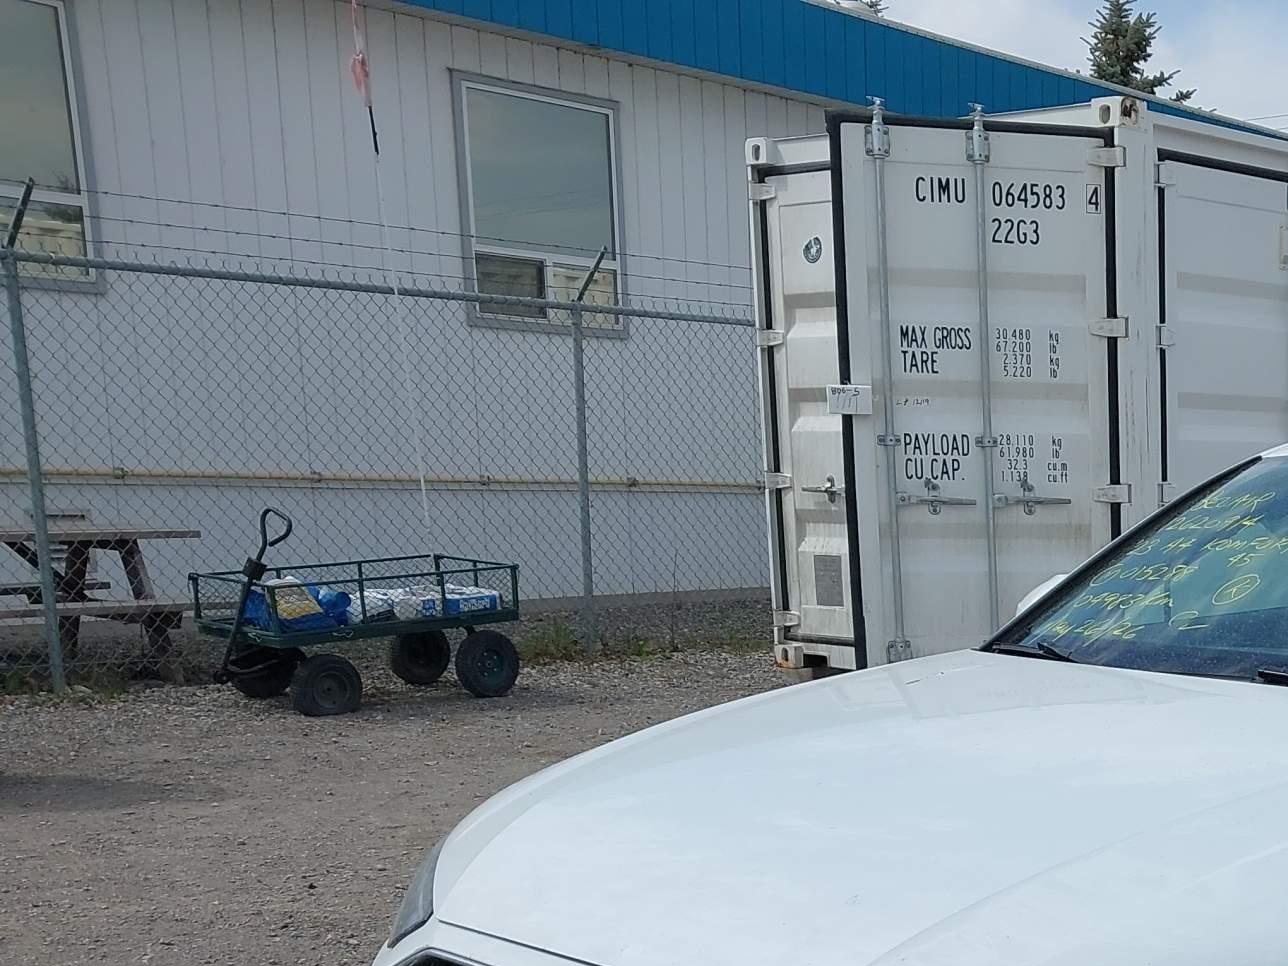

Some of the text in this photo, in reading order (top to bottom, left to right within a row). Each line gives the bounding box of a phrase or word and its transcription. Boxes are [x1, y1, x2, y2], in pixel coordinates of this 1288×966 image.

[915, 176, 1100, 212] CIMU 064583 4
[991, 217, 1040, 245] 22G3
[900, 325, 1060, 350] MAX GROSS 30.480 kg
[995, 340, 1057, 354] 67.200 lb
[901, 350, 1060, 374] TARE 2.370 kg
[1003, 366, 1058, 379] 5.220 lb
[903, 432, 1062, 457] PAYLOAD 28.110 kg
[1000, 446, 1060, 459] 61.980 lb
[1007, 458, 1028, 471] 32.3
[1047, 460, 1068, 471] cu.m
[1001, 470, 1068, 484] 1.138 cu.ft
